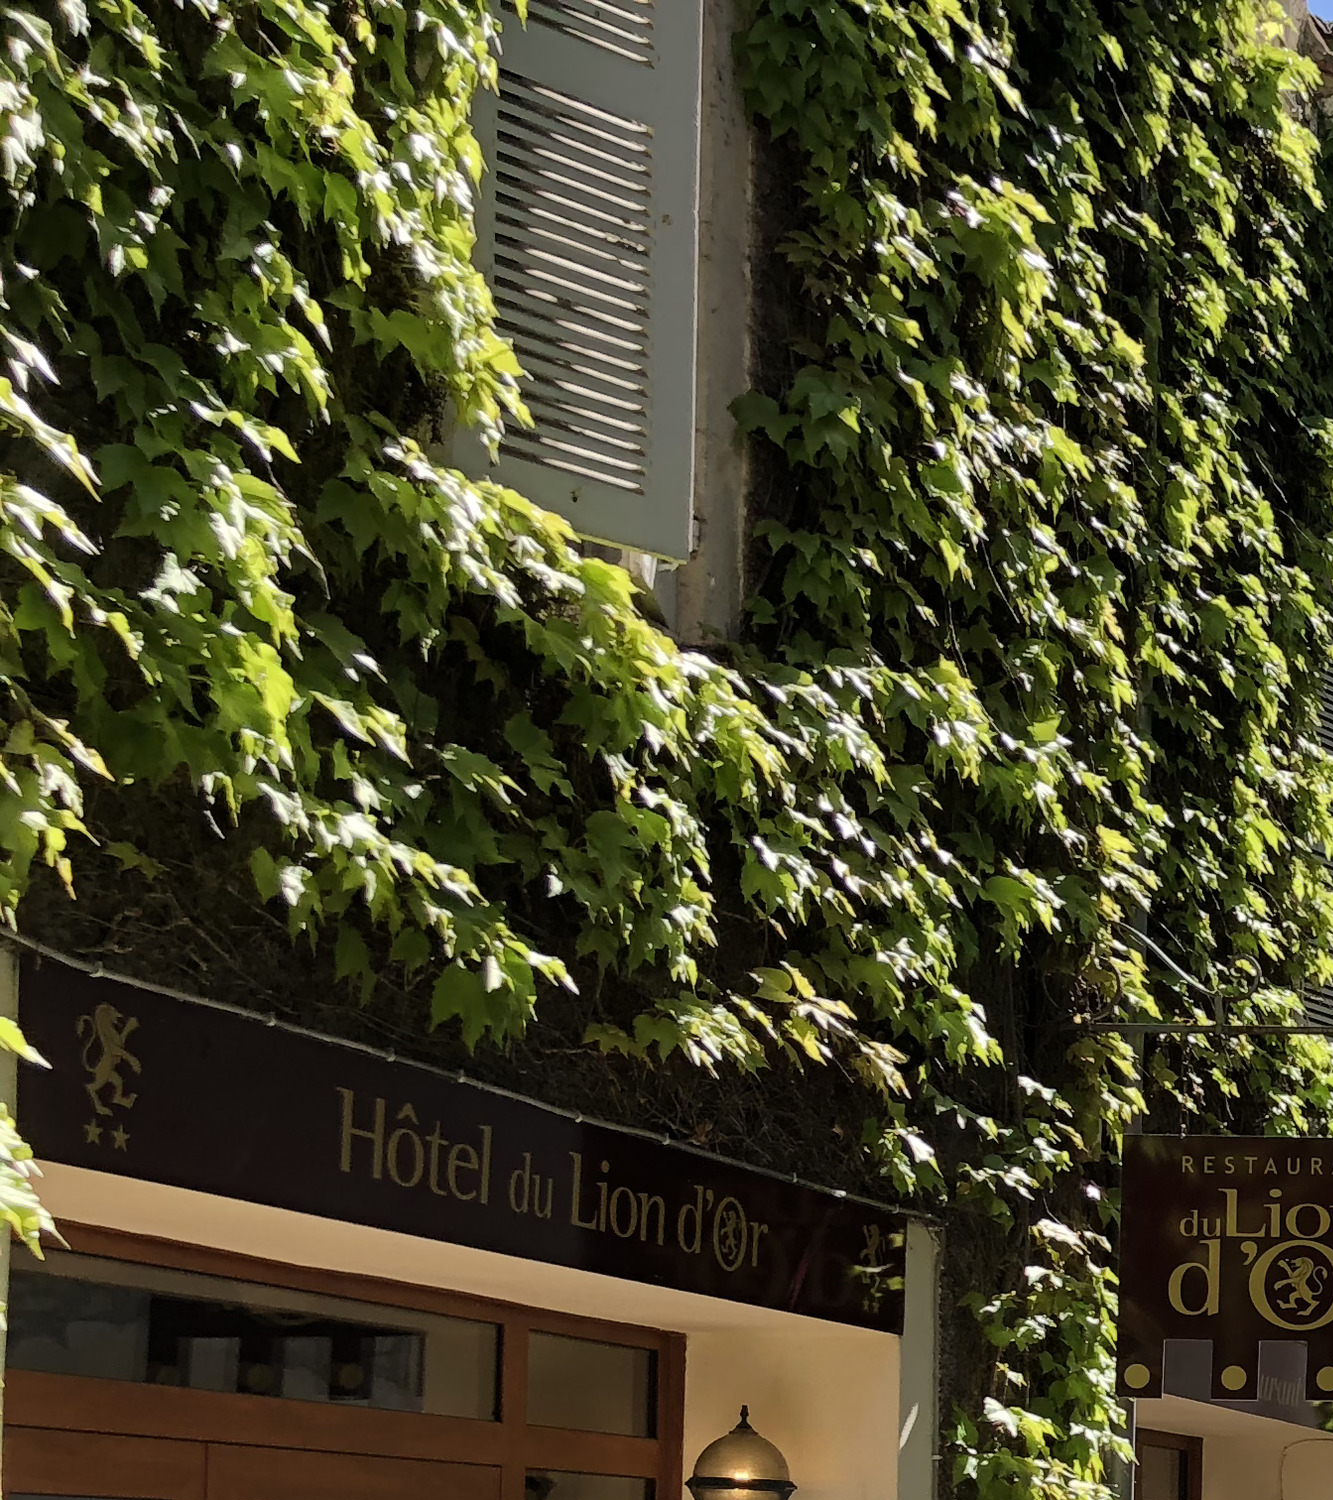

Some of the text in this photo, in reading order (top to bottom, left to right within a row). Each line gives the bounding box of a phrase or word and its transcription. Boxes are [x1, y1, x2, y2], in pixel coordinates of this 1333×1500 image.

[336, 1087, 769, 1272] Hôtel du Lion d'Or
[1179, 1210, 1221, 1237] du
